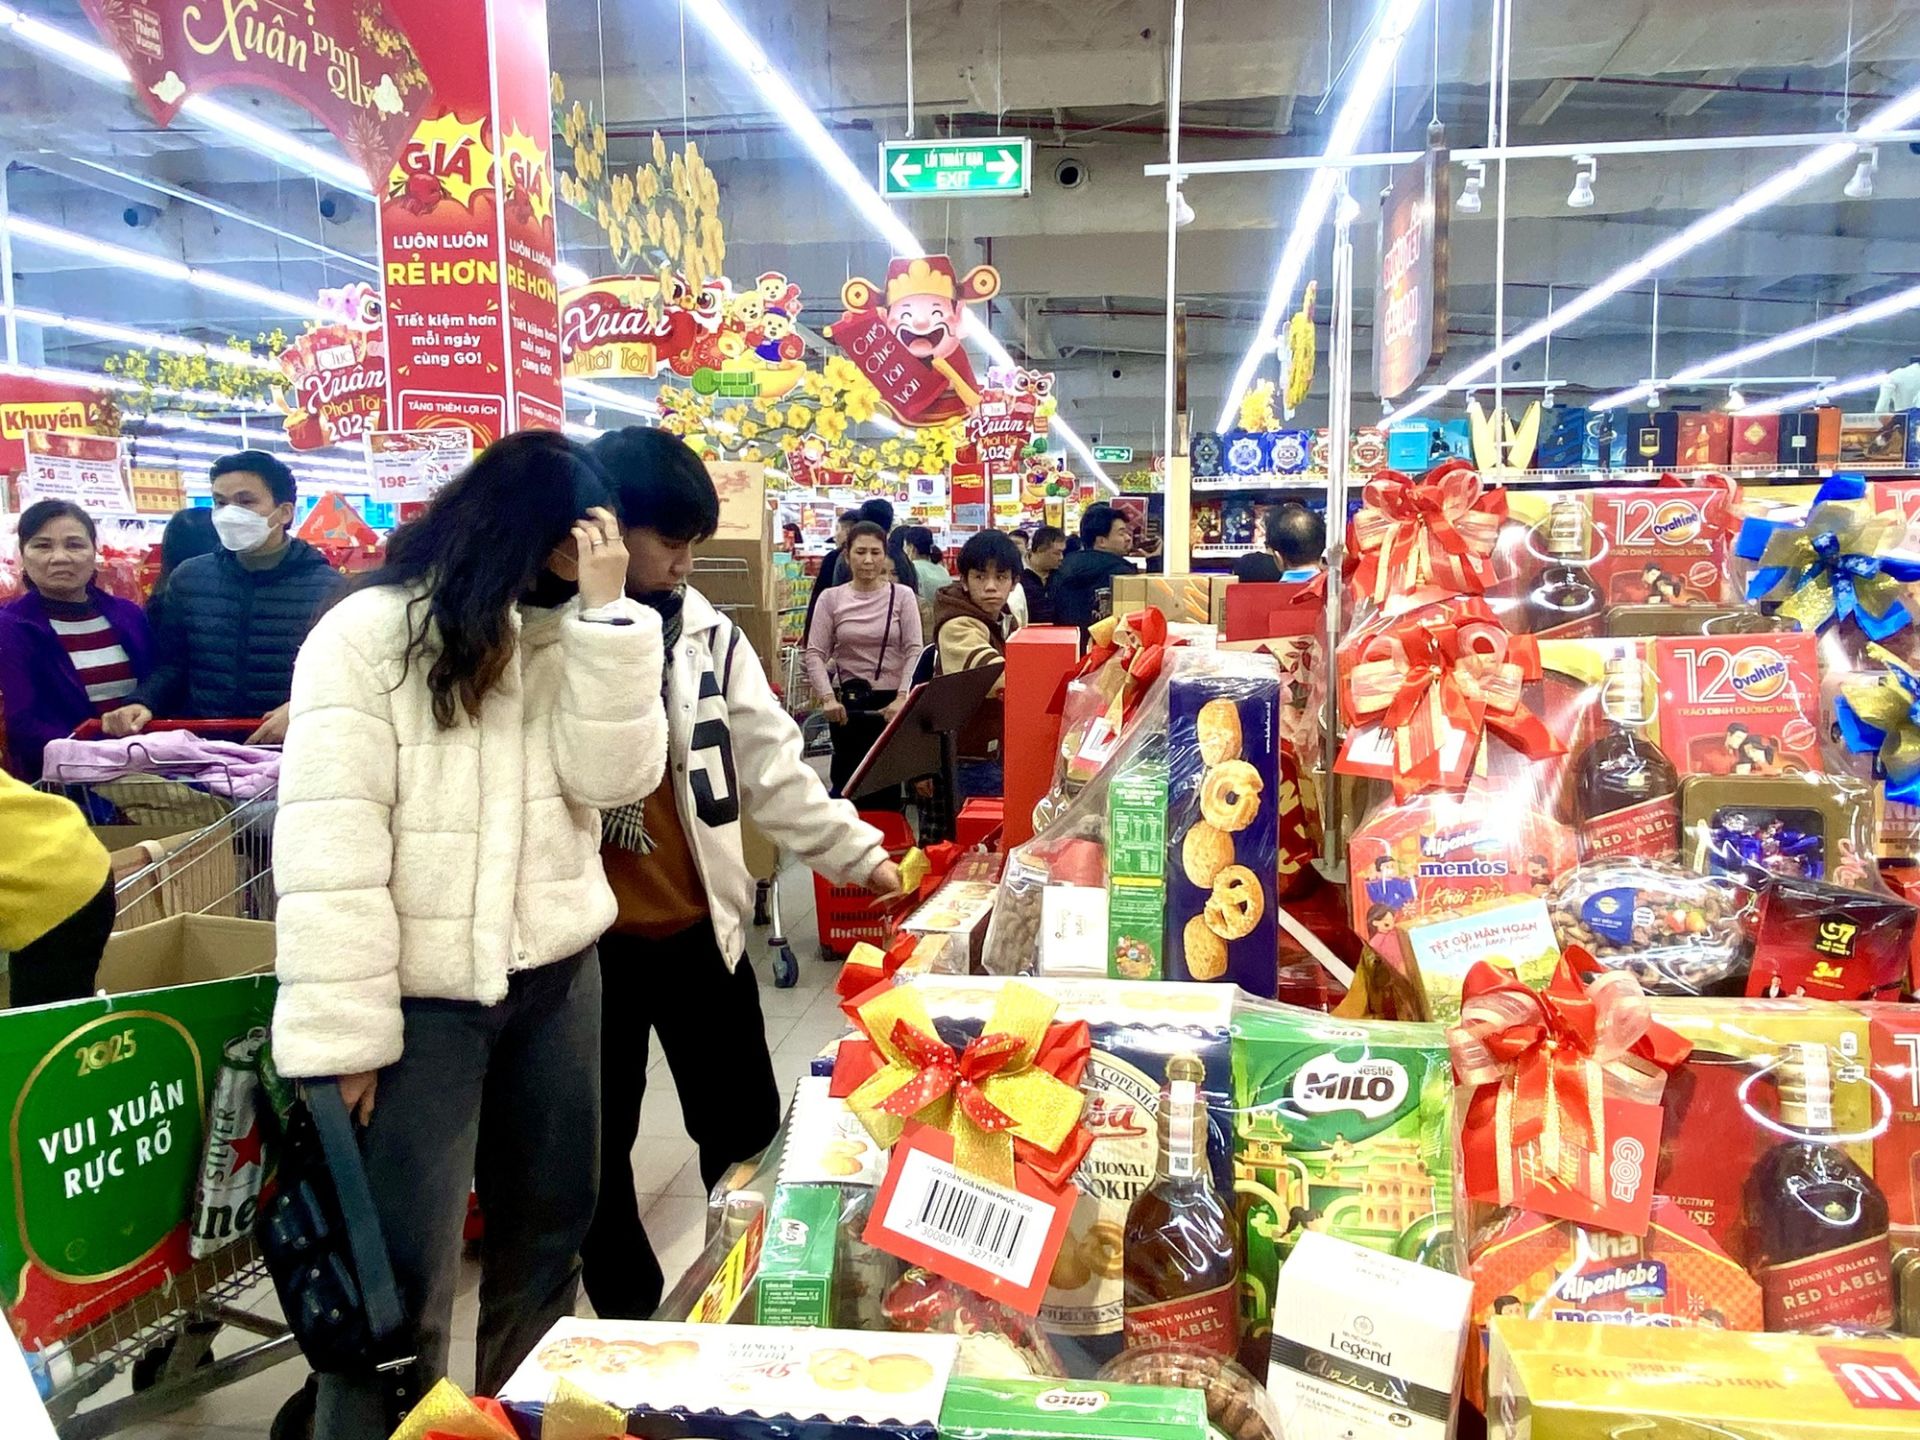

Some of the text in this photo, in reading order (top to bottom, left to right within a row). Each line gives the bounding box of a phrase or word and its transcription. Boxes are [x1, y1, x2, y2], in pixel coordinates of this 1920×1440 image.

[183, 0, 307, 72] Xuân
[399, 138, 472, 185] GIÁ
[510, 152, 543, 196] GIÁ
[393, 230, 489, 249] LUÔN LUÔN
[509, 238, 531, 260] LUÔN
[387, 253, 499, 287] RẺ HƠN
[508, 259, 557, 305] RẺ HƠN
[395, 314, 497, 329] Tiết kiệm hơn
[411, 330, 480, 349] mỗi ngày
[413, 352, 483, 368] cùng GO!
[304, 363, 387, 415] Xuân
[4, 405, 83, 431] Khuyến
[328, 411, 379, 441] 2025
[970, 415, 1025, 443] Xuân
[980, 445, 1012, 461] 2025
[1653, 512, 1699, 536] Ovaltine
[1732, 660, 1786, 691] Ovaltine
[1592, 817, 1674, 850] RED LABEL
[1419, 860, 1508, 876] mentos
[1820, 922, 1856, 944] G7
[75, 1029, 137, 1077] 2025
[1302, 1072, 1396, 1103] MILO
[38, 1079, 185, 1165] VUI XUÂN
[63, 1118, 173, 1199] RỰC RỖ
[205, 1107, 236, 1183] SILVER
[904, 1219, 913, 1230] 2
[1562, 1262, 1658, 1305] Alpenliebe
[1782, 1269, 1888, 1311] RED LABEL
[1788, 1270, 1834, 1291] JOHNNIE
[1131, 1314, 1174, 1331] JOHNNIE
[1167, 1319, 1225, 1342] LABEL
[1330, 1332, 1392, 1367] Legend
